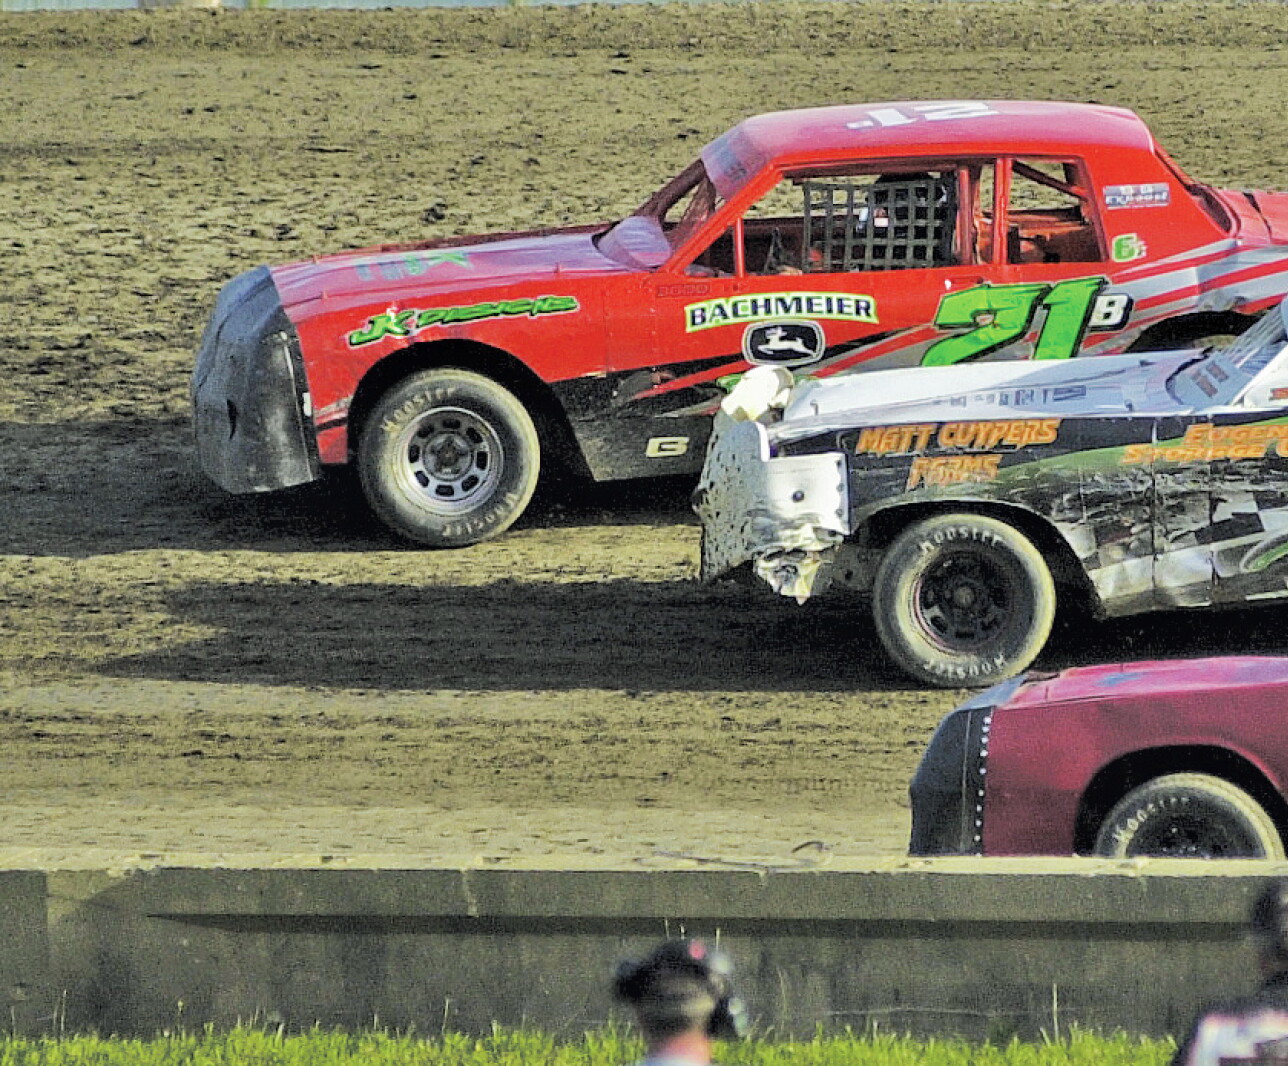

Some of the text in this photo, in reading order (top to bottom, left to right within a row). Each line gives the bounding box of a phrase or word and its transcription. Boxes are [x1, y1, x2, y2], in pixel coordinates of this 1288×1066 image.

[690, 294, 873, 326] BACHMEIER
[856, 418, 1064, 457] MATT CUYPERS
